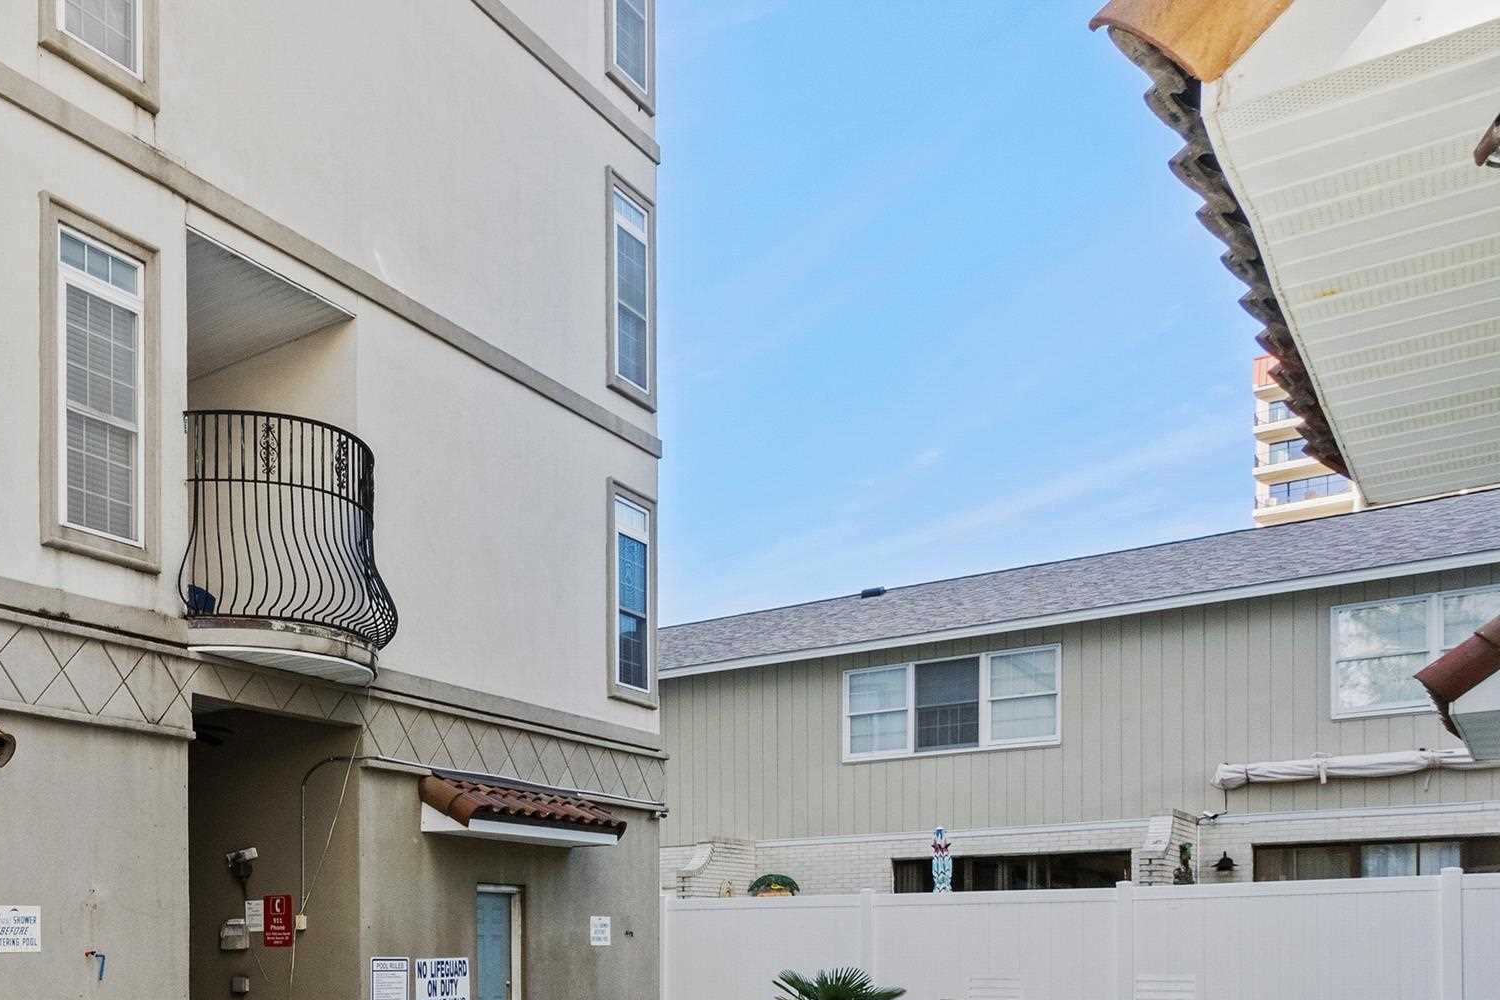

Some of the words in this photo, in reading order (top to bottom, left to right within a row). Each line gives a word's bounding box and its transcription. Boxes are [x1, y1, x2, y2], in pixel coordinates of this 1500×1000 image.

[13, 915, 37, 924] SHOWER
[0, 926, 29, 936] BEFORE
[22, 937, 37, 946] POOL
[417, 961, 427, 979] NO
[430, 960, 467, 978] LIFEGUARD
[428, 979, 437, 998] ON
[440, 978, 459, 996] DUTY
